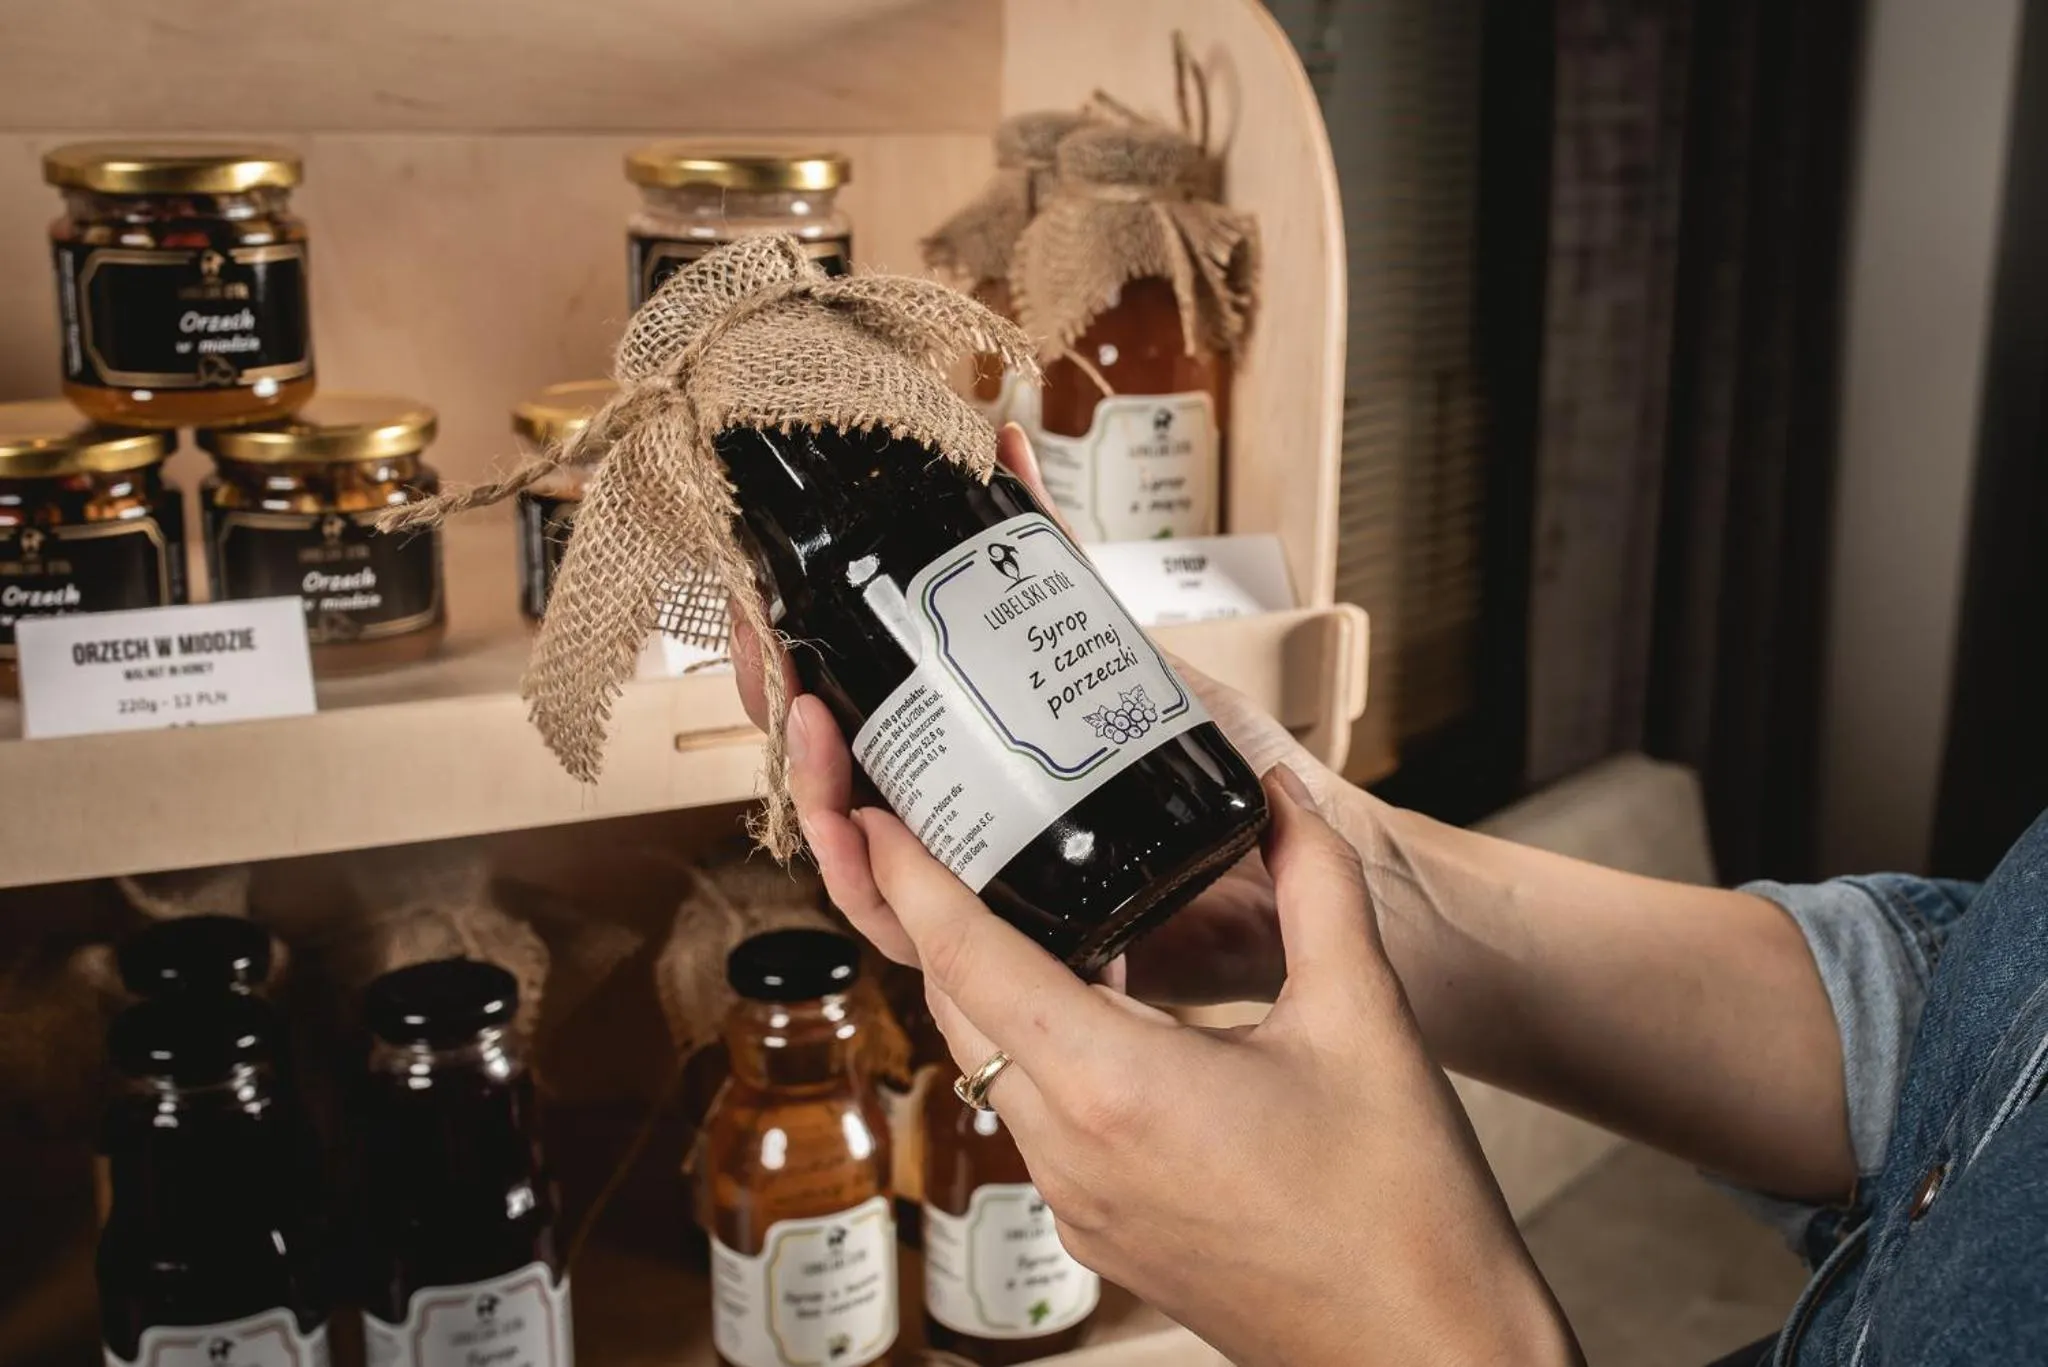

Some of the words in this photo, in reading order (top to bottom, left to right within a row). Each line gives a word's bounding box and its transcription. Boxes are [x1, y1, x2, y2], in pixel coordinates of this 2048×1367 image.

[179, 308, 256, 333] Orzech
[302, 566, 377, 591] Orzech
[983, 576, 1048, 631] LUBELSKI
[1043, 569, 1075, 596] STÓŁ
[72, 635, 150, 666] ORZECH
[154, 637, 172, 658] W
[178, 627, 257, 655] MIODZIE
[1027, 610, 1089, 653] Syrop
[1028, 671, 1046, 691] z
[1054, 623, 1121, 673] czarnej
[1046, 645, 1138, 719] porzeczki
[117, 697, 159, 715] 220g
[173, 694, 192, 709] 12
